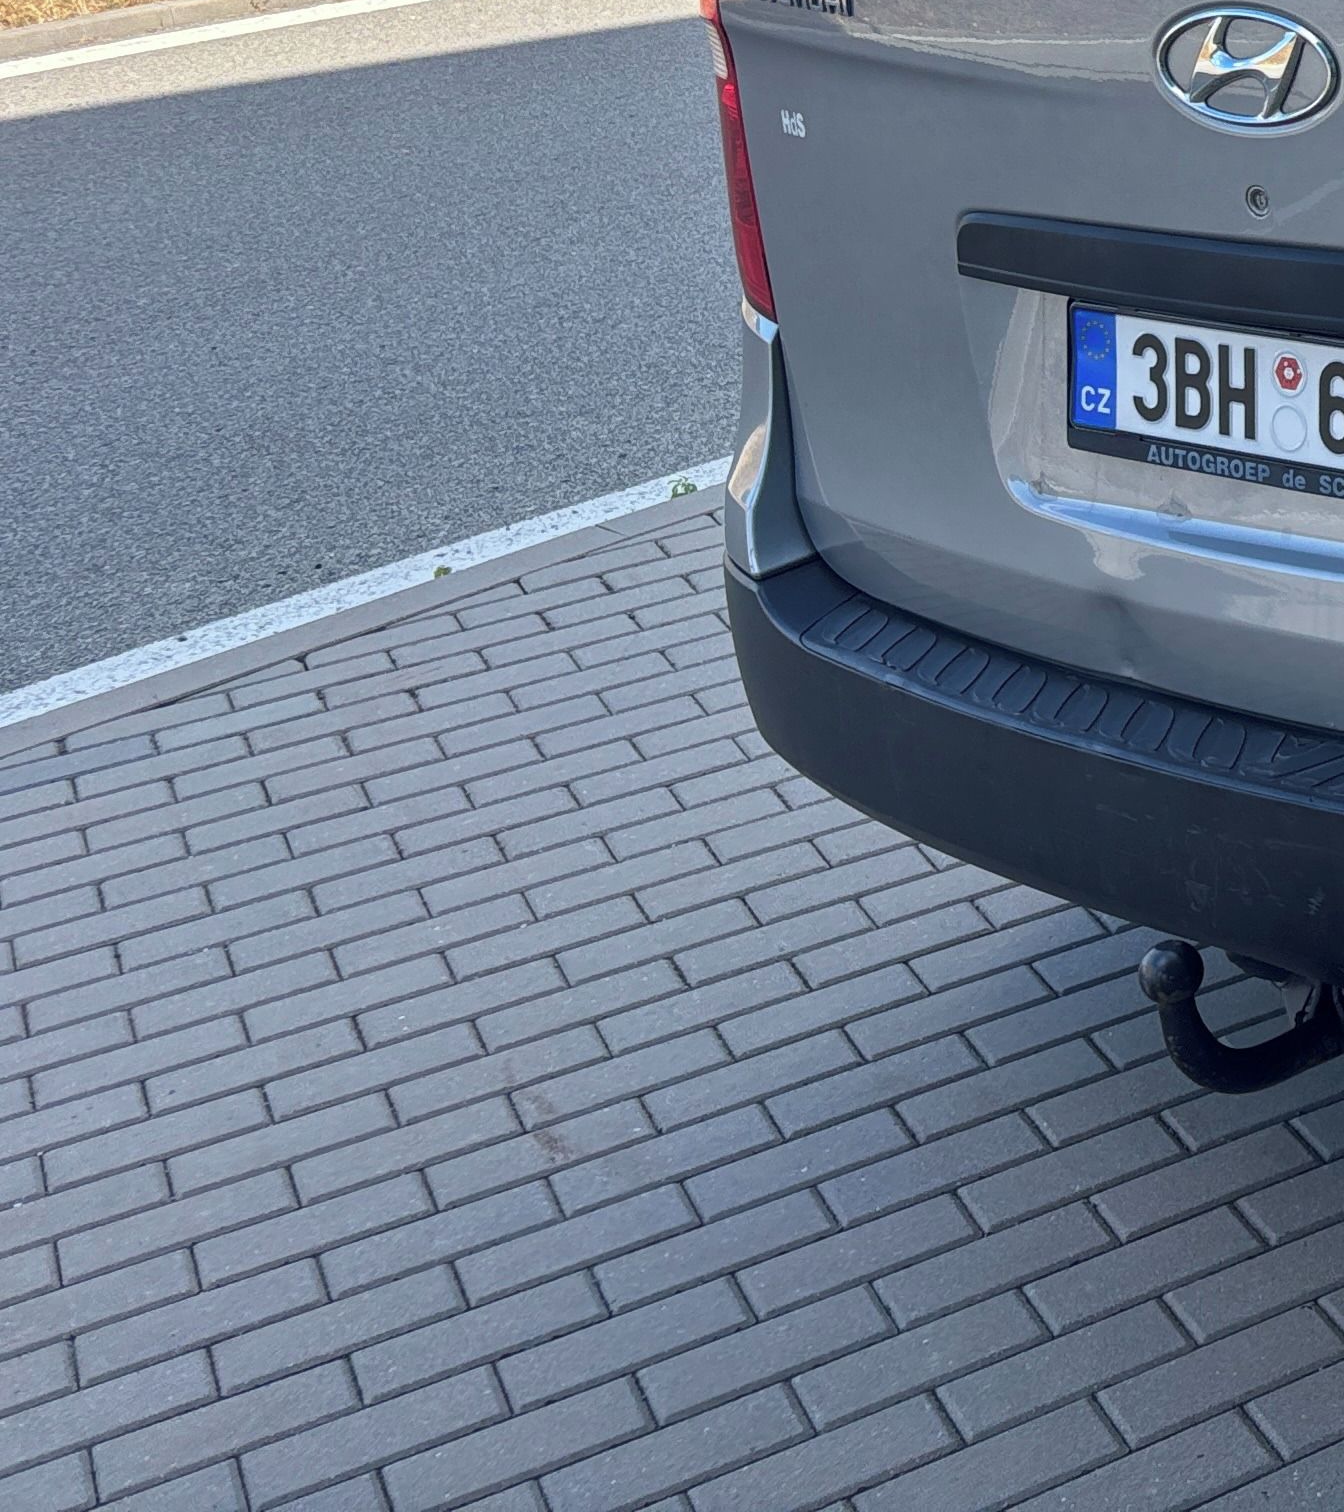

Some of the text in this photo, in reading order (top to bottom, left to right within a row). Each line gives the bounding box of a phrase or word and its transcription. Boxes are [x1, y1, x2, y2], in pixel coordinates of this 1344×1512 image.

[1080, 385, 1111, 414] CZ
[1132, 332, 1257, 440] 3BH
[1147, 444, 1270, 483] AUTOGROEP
[1283, 468, 1306, 490] de
